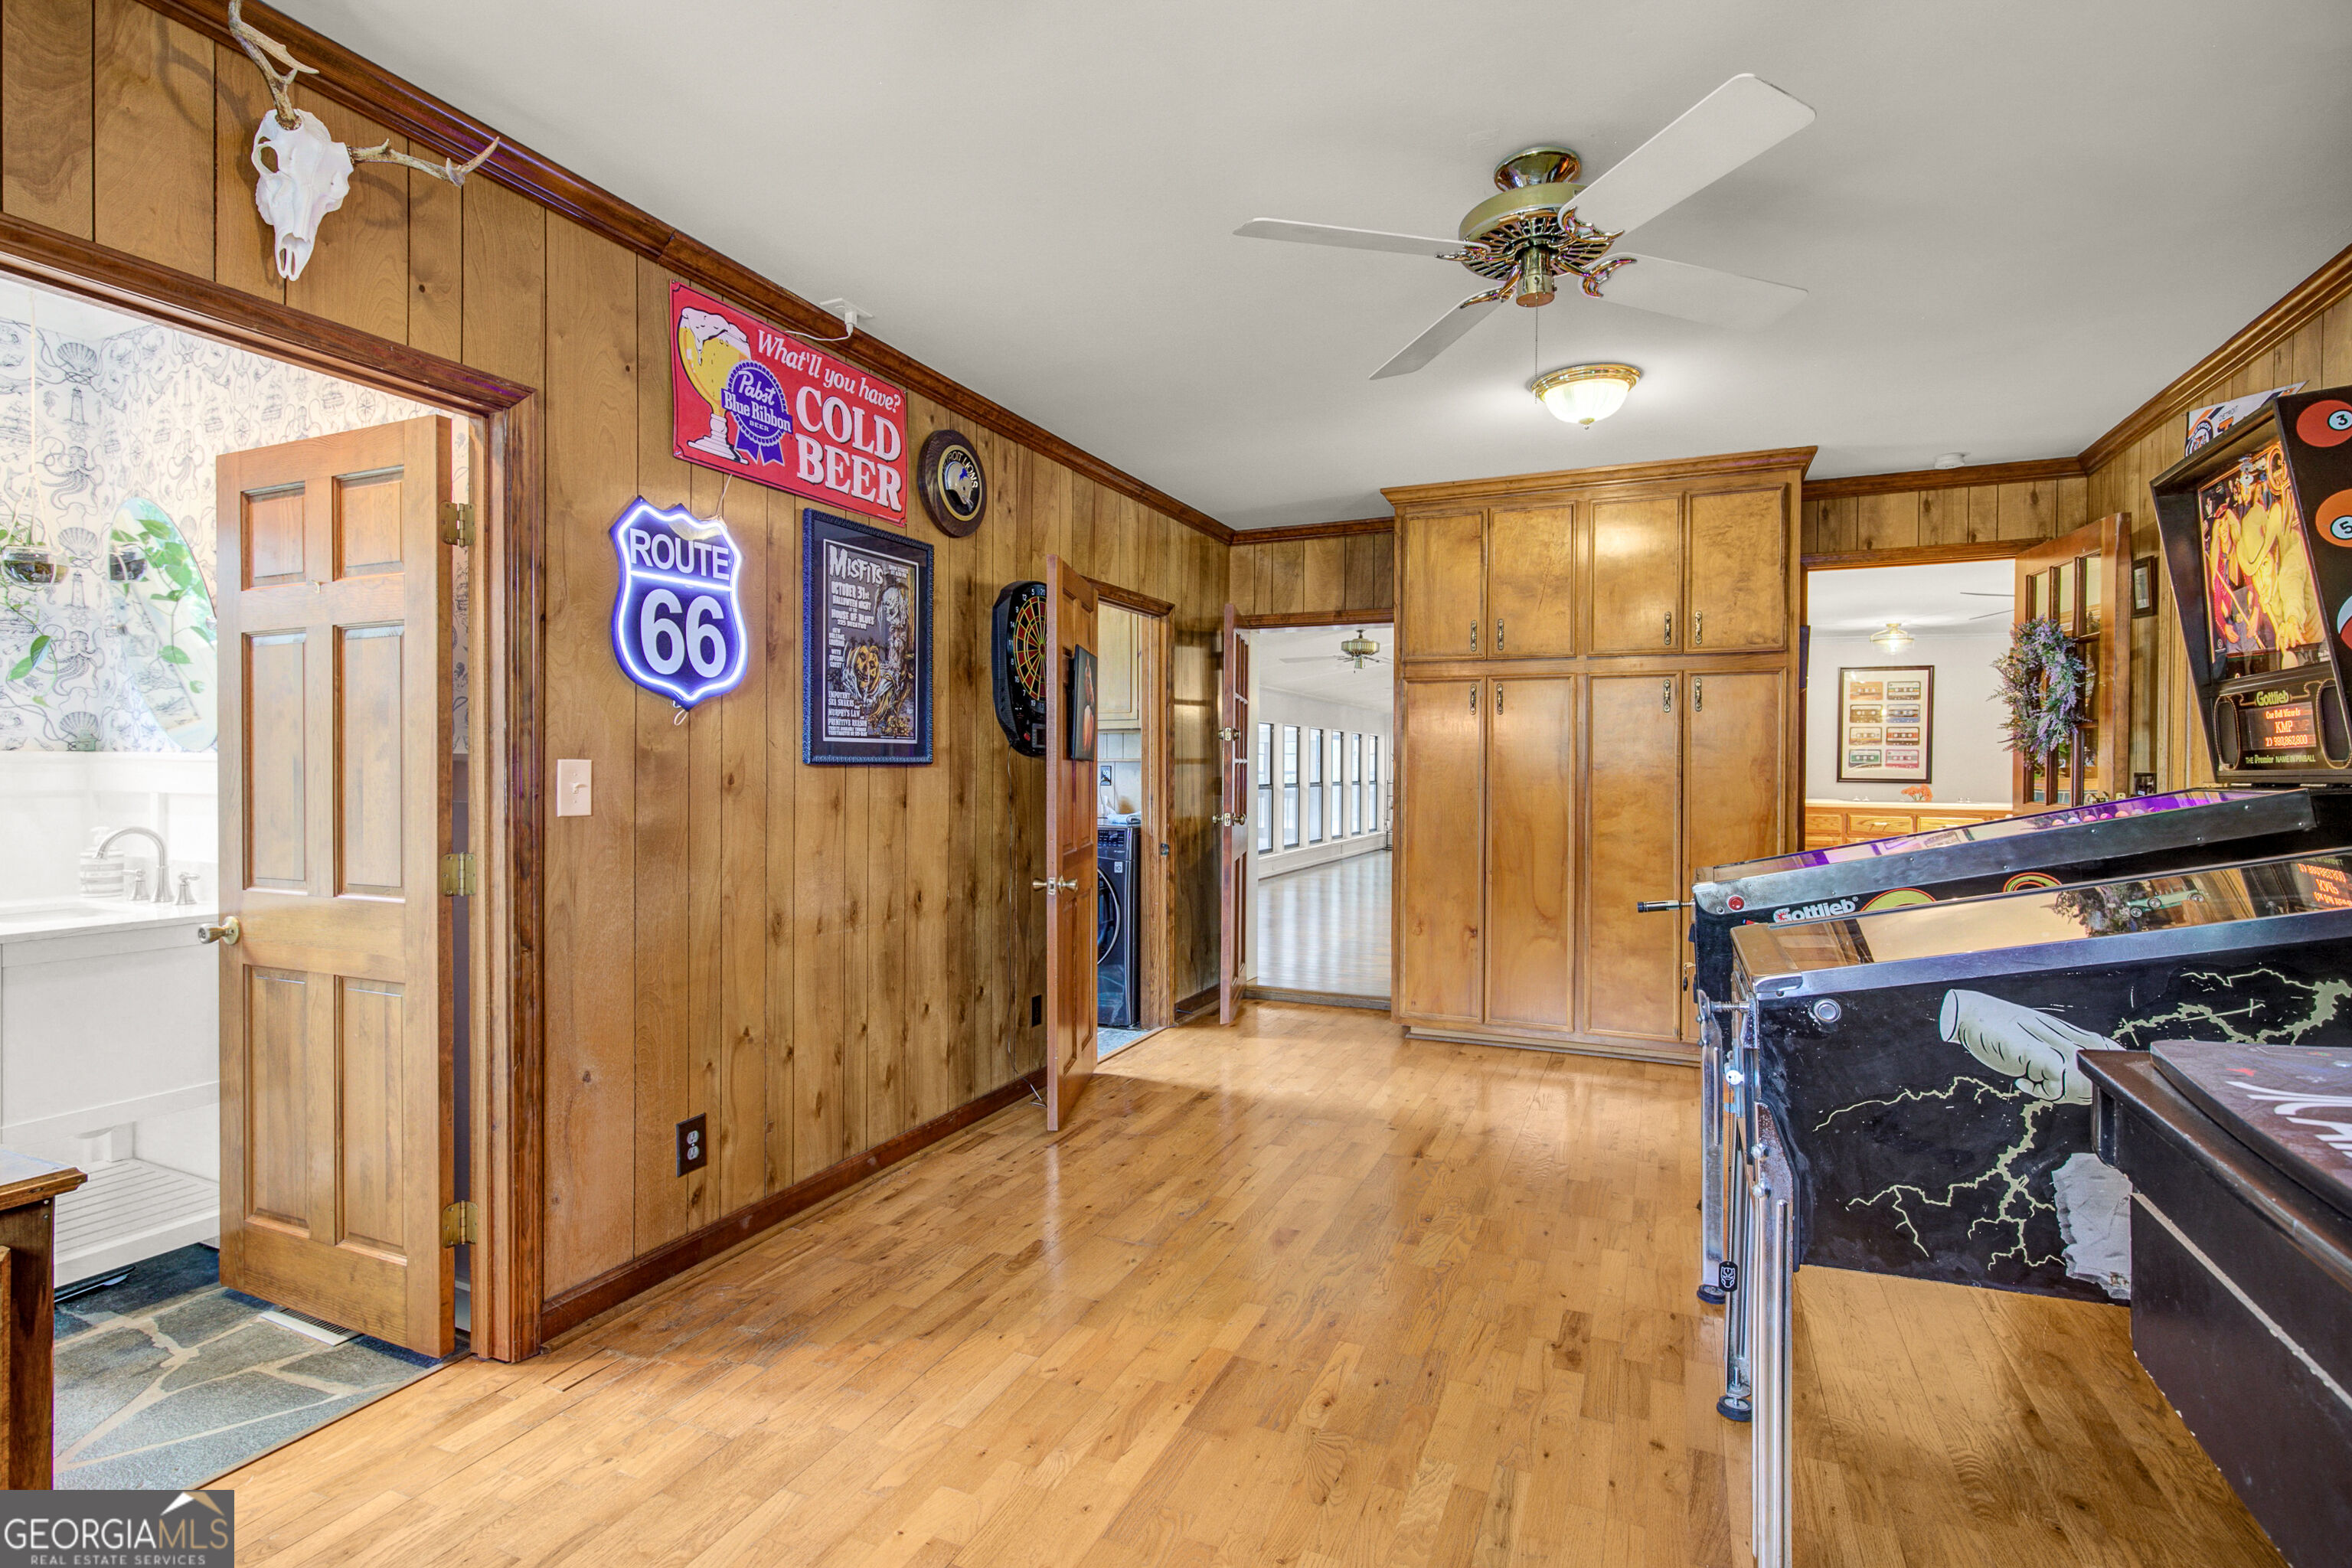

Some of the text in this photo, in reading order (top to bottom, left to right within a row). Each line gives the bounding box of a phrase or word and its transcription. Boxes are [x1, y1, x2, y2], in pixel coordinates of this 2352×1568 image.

[757, 329, 901, 413] What'll you have?
[738, 371, 776, 405] Pabst
[724, 390, 792, 433] Blue Ribbon
[796, 386, 901, 461] COLD
[2336, 414, 2348, 426] 3
[750, 420, 769, 432] BEER
[795, 433, 901, 511] BEER
[962, 457, 978, 488] LIONS
[2340, 521, 2352, 534] 5
[630, 528, 730, 580] ROUTE
[831, 581, 870, 599] OCTOBER 31st
[831, 609, 874, 625] HOUSE OF BLUES
[640, 589, 726, 678] 66
[2256, 690, 2289, 706] Gottlieb
[2275, 720, 2293, 733] KMP
[1772, 899, 1856, 923] Gottlieb
